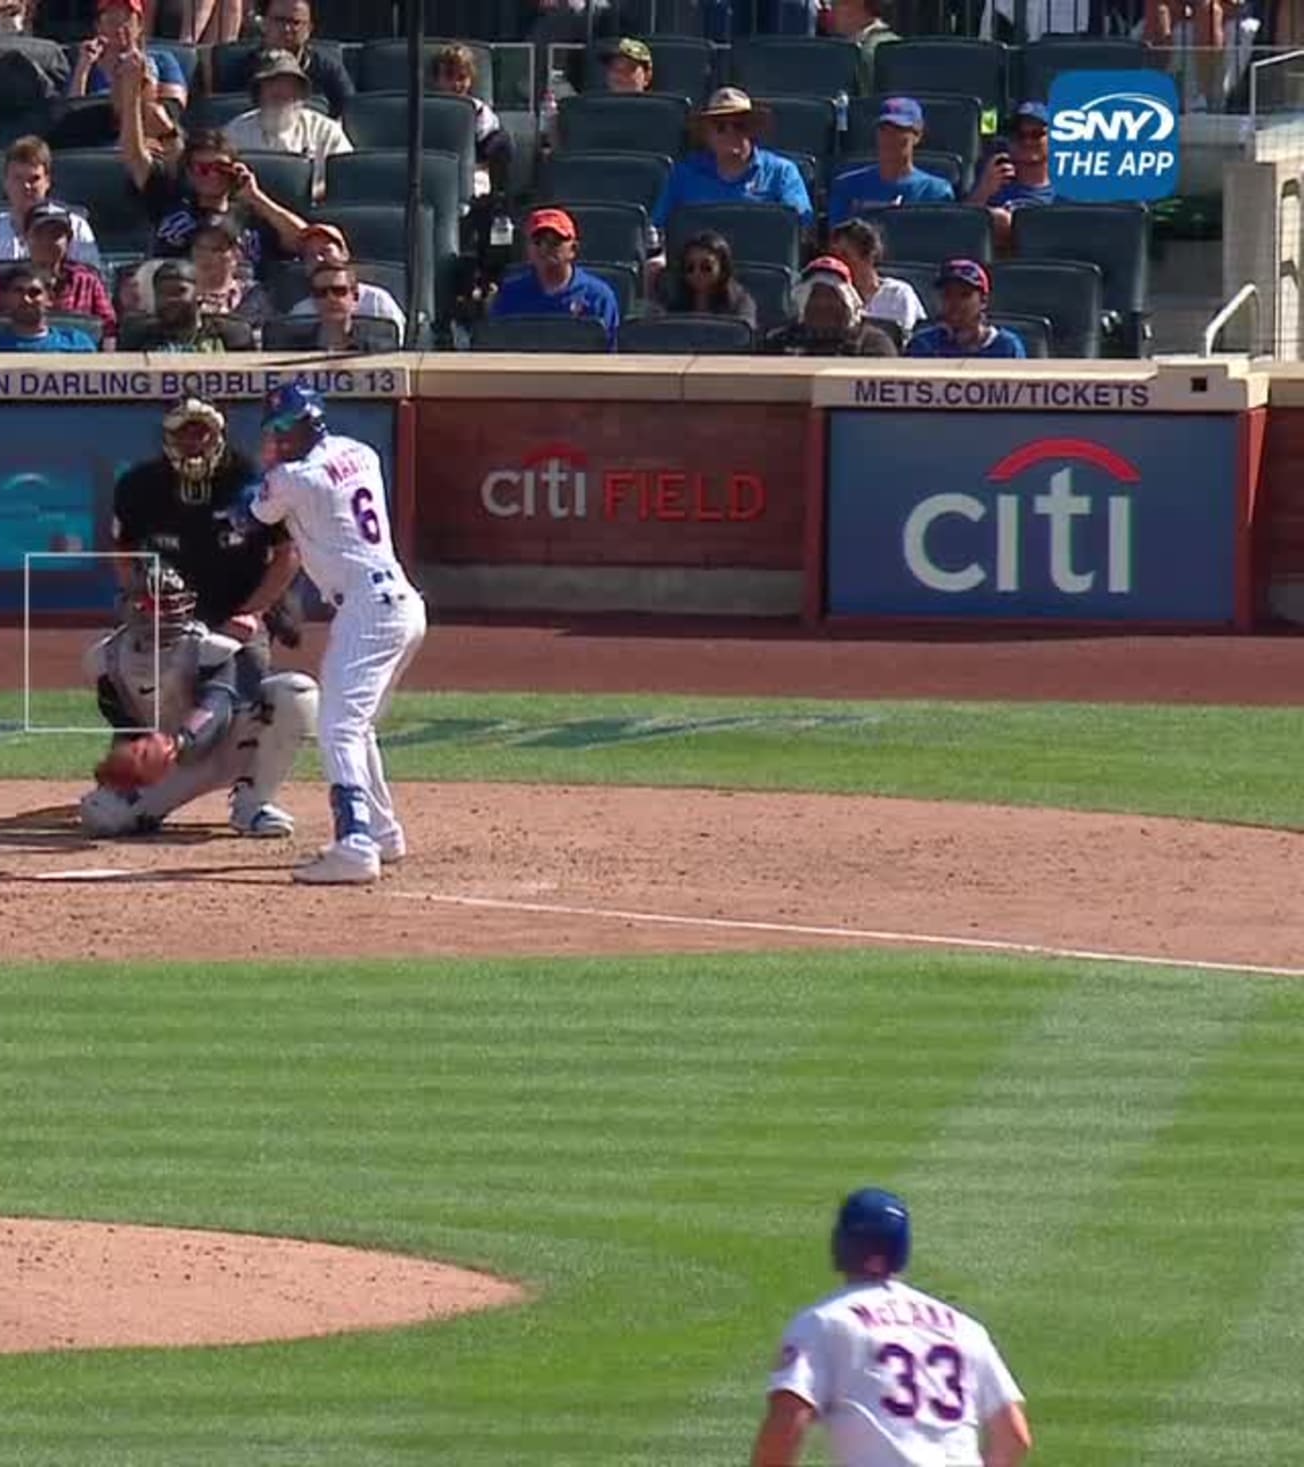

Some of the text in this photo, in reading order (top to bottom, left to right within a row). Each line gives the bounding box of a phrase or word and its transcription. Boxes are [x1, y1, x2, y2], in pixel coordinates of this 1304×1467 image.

[20, 372, 151, 395] DARLING
[162, 371, 281, 394] BOBBLE
[364, 371, 395, 393] 13
[854, 380, 1150, 407] METS.COM/TICKETS
[351, 486, 382, 545] 6
[481, 457, 767, 521] citi FIELD
[903, 466, 1131, 593] citi
[875, 1343, 965, 1423] 33
